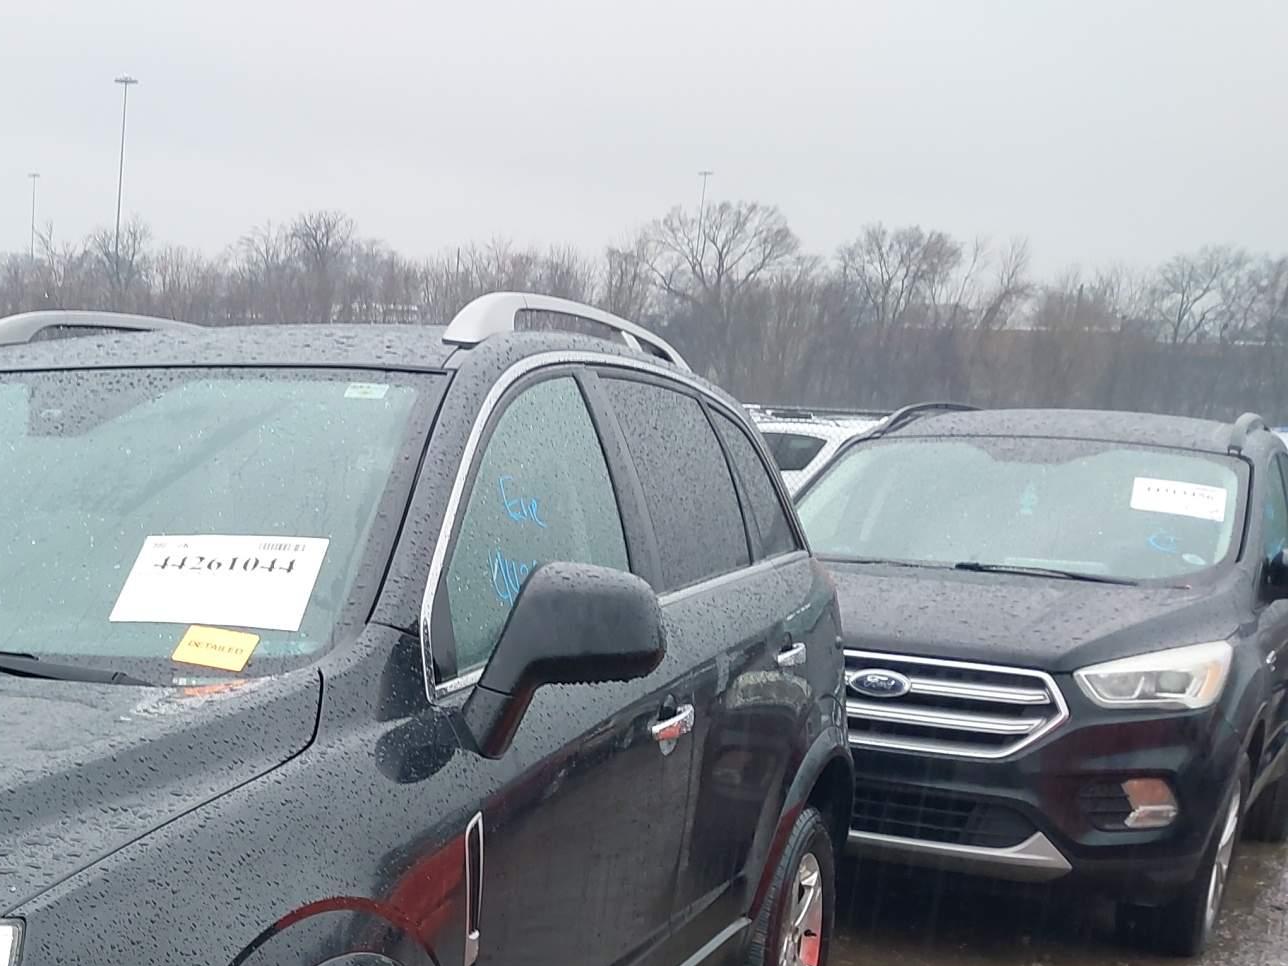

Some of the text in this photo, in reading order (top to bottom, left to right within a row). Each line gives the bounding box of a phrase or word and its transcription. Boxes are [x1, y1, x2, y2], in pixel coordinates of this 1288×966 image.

[153, 556, 296, 573] 44261044
[187, 640, 244, 655] DETAILED
[863, 674, 896, 690] Ford
